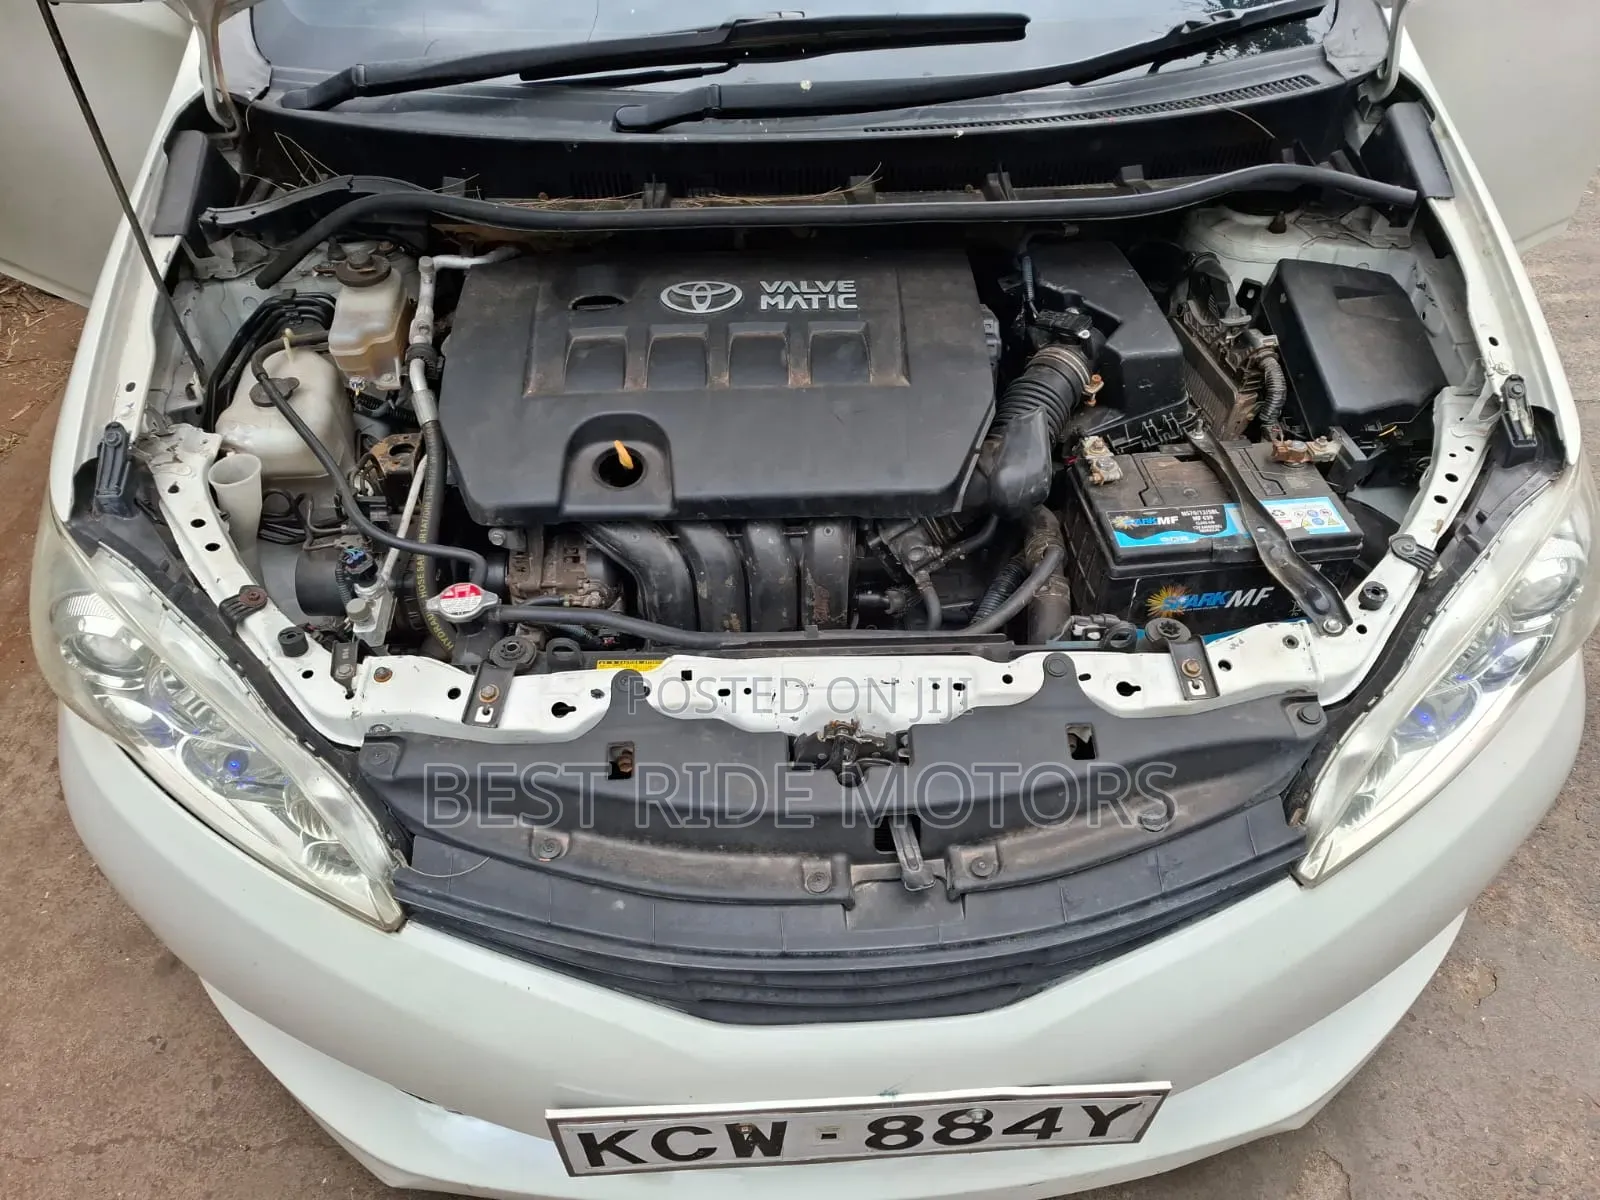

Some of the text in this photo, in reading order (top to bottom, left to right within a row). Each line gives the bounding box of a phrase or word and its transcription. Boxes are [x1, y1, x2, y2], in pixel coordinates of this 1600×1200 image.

[760, 280, 857, 293] VALVE
[760, 294, 858, 310] MATIC
[417, 573, 428, 598] HOSE
[577, 1102, 1142, 1167] KCW 884Y
